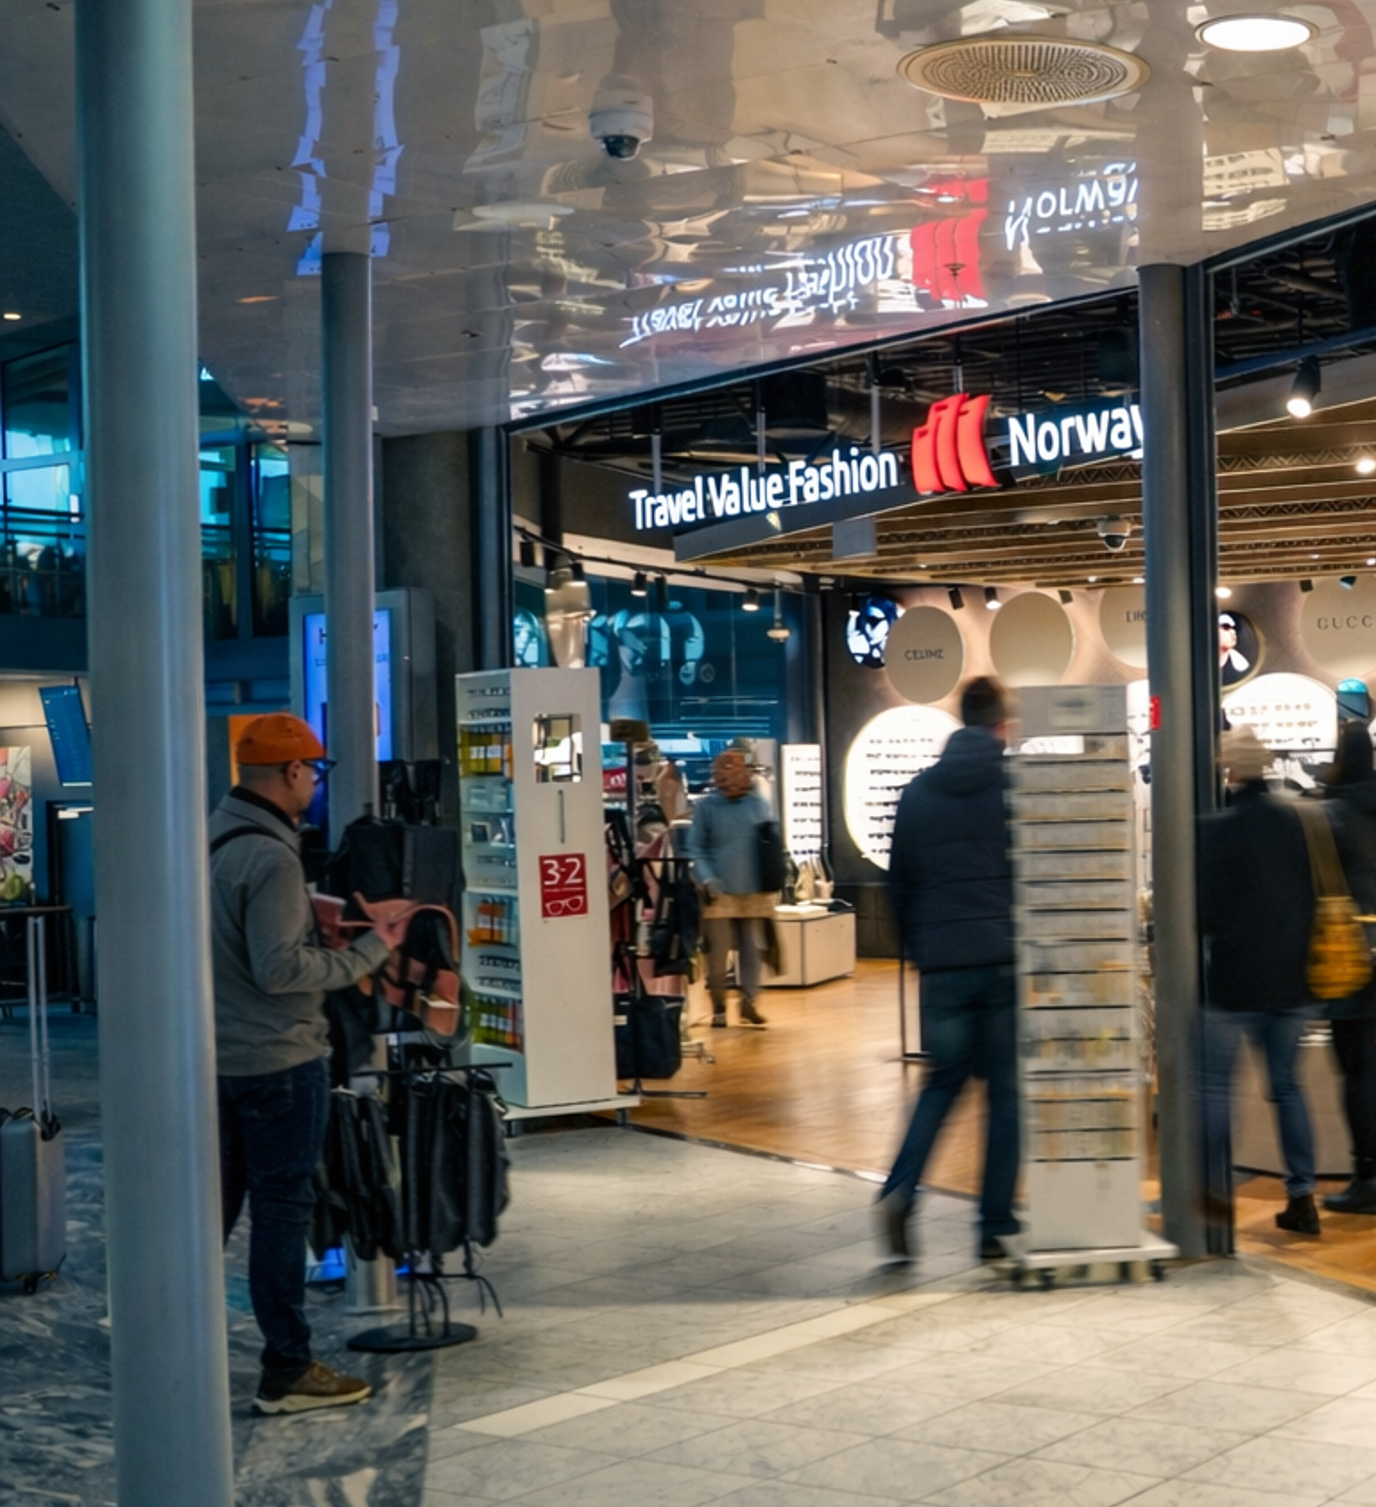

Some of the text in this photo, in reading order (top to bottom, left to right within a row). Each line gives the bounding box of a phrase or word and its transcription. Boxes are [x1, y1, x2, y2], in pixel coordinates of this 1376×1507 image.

[629, 475, 705, 530] Travel
[707, 466, 784, 517] Value
[788, 447, 899, 507] Fashion
